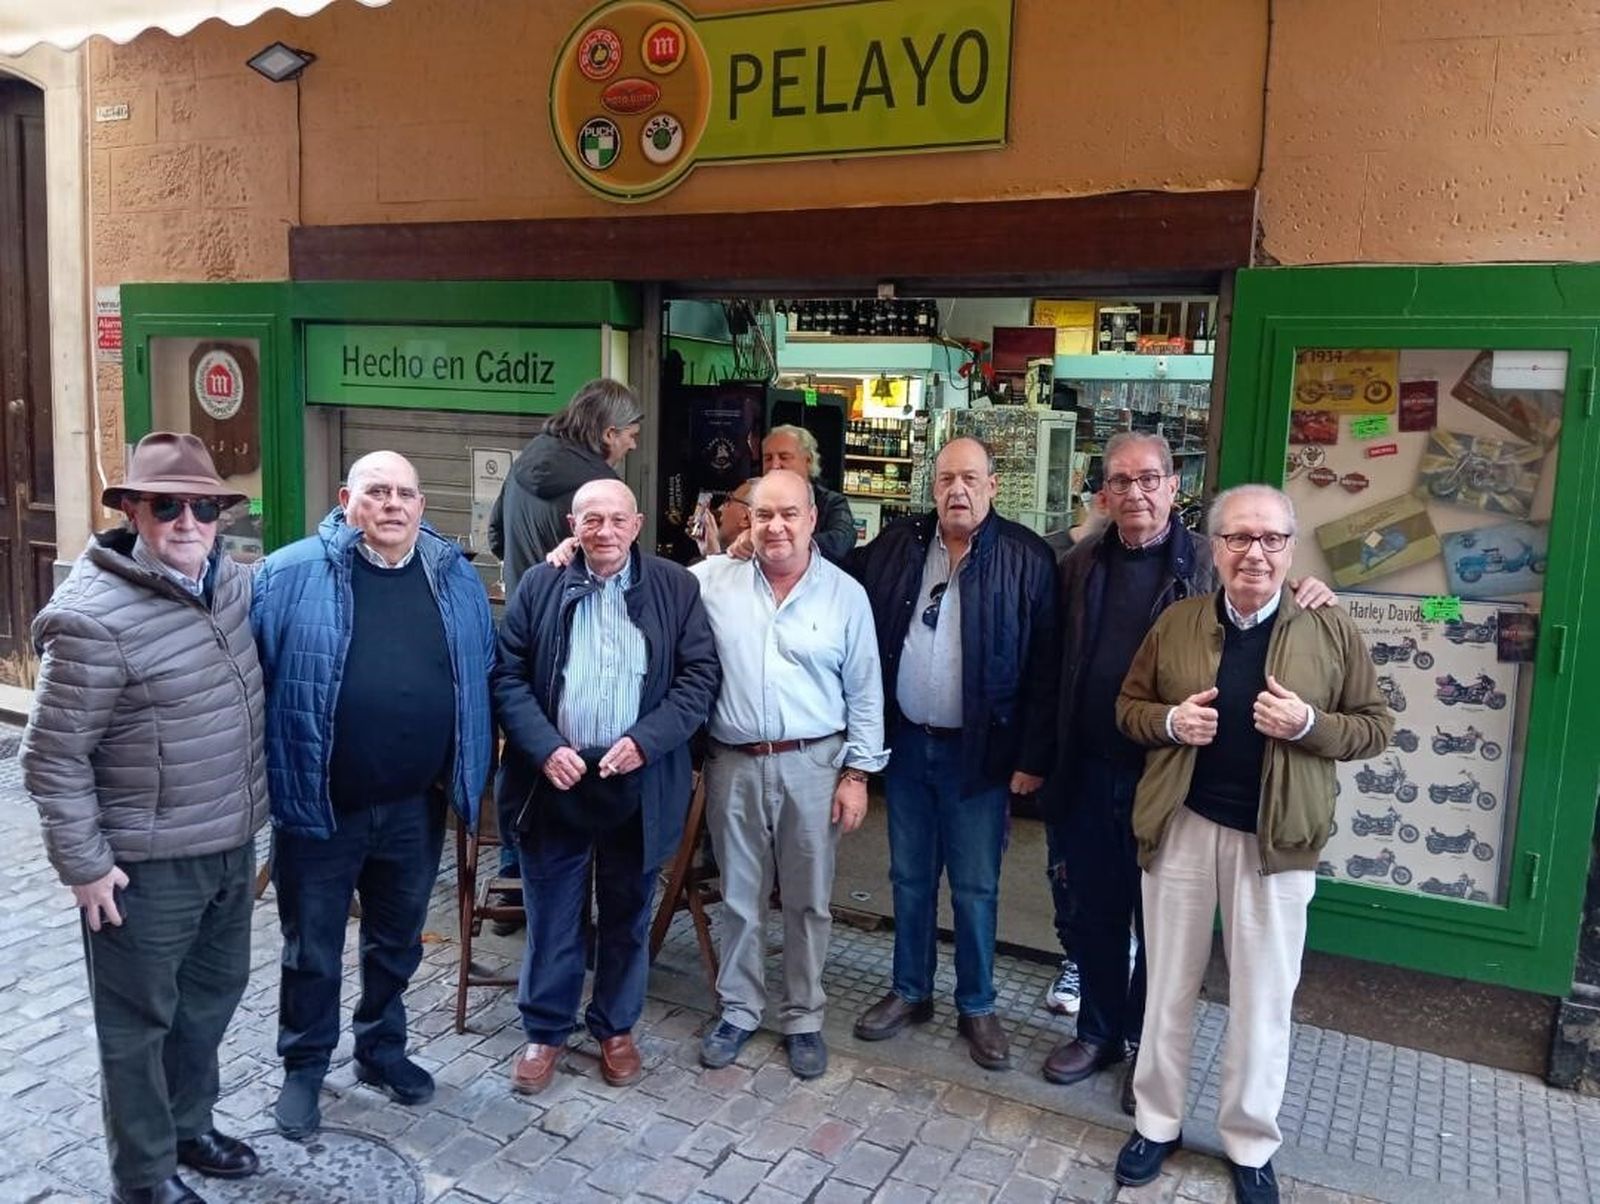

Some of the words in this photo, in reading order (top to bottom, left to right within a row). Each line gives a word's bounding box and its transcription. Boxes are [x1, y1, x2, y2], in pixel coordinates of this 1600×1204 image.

[729, 28, 990, 121] PELAYO
[584, 126, 614, 137] PUCH
[645, 116, 679, 138] OSSA
[342, 344, 424, 380] Hecho
[432, 355, 465, 380] en
[475, 349, 555, 385] Cádiz
[1311, 350, 1343, 363] 1934
[1349, 600, 1385, 624] Harley
[1387, 603, 1427, 624] Davids
